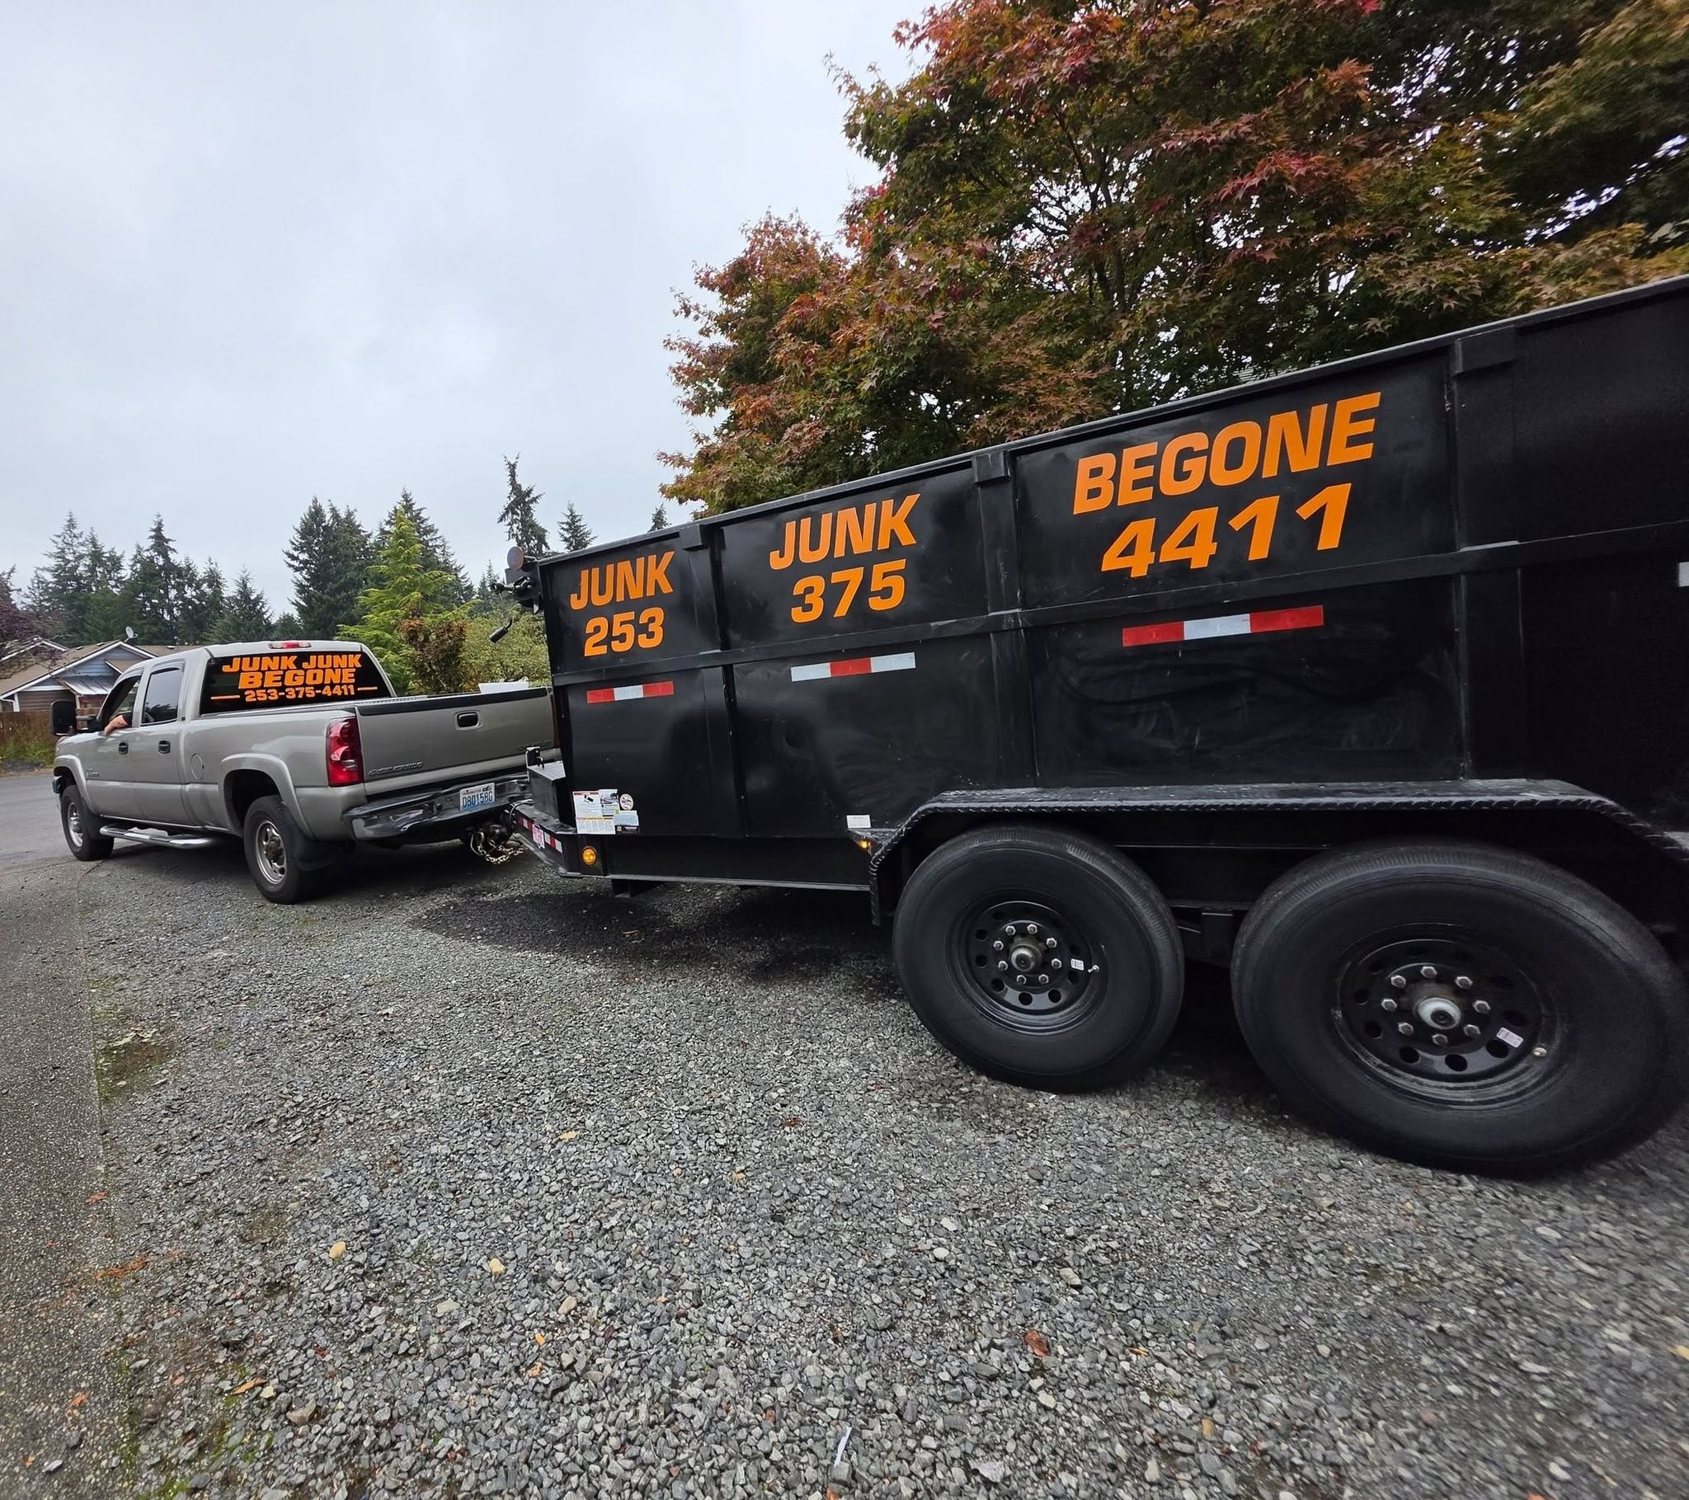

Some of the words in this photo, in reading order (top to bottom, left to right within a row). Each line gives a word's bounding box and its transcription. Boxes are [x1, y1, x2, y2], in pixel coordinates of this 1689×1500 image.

[569, 552, 674, 610] JUNK
[769, 494, 917, 569] JUNK
[1073, 392, 1381, 514] BEGONE
[583, 607, 665, 657] 253
[790, 559, 906, 623] 375
[1101, 482, 1352, 578] 4411
[222, 656, 296, 673] JUNK
[302, 654, 362, 669] JUNK
[238, 668, 355, 689] BEGONE
[244, 684, 355, 702] 253-375-4411
